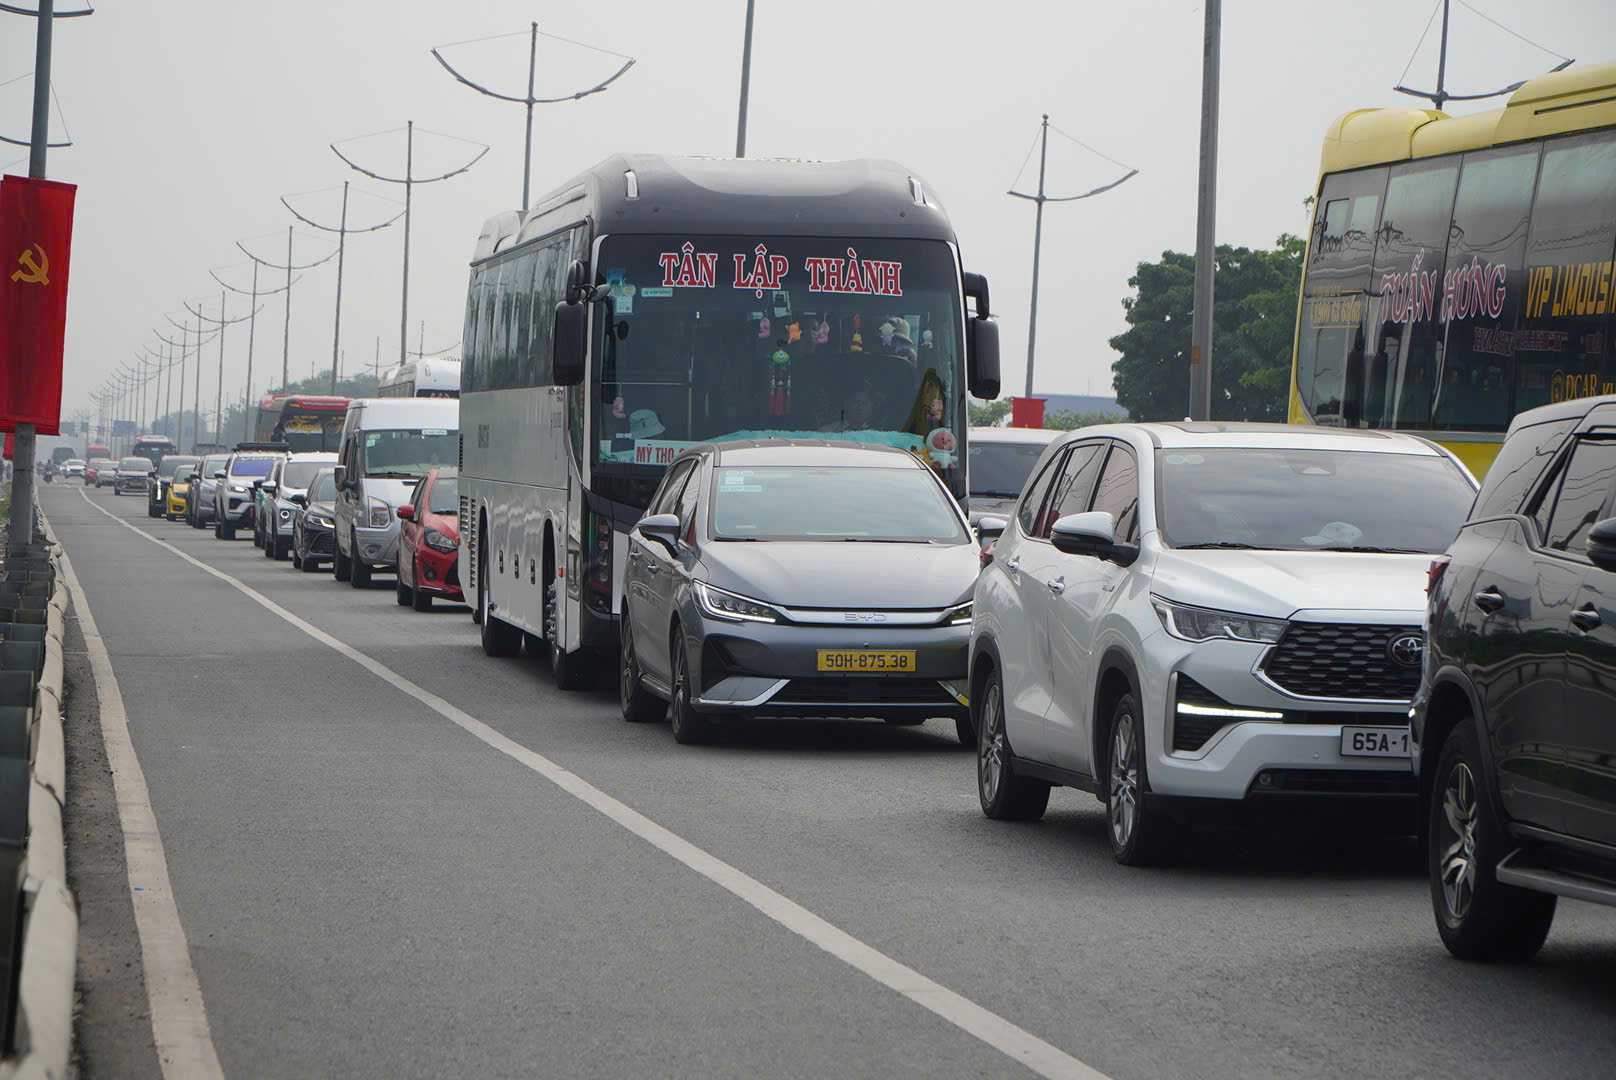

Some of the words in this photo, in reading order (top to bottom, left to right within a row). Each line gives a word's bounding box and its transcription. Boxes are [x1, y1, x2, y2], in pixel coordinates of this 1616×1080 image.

[659, 241, 718, 288] TÂN
[733, 243, 789, 299] LẬP
[805, 247, 903, 297] THÀNH
[1380, 248, 1438, 325] TUẤN
[1526, 266, 1553, 319] VIP
[844, 612, 888, 622] BYD
[825, 654, 908, 668] 50H-875.38
[1352, 732, 1409, 753] 65A-1
